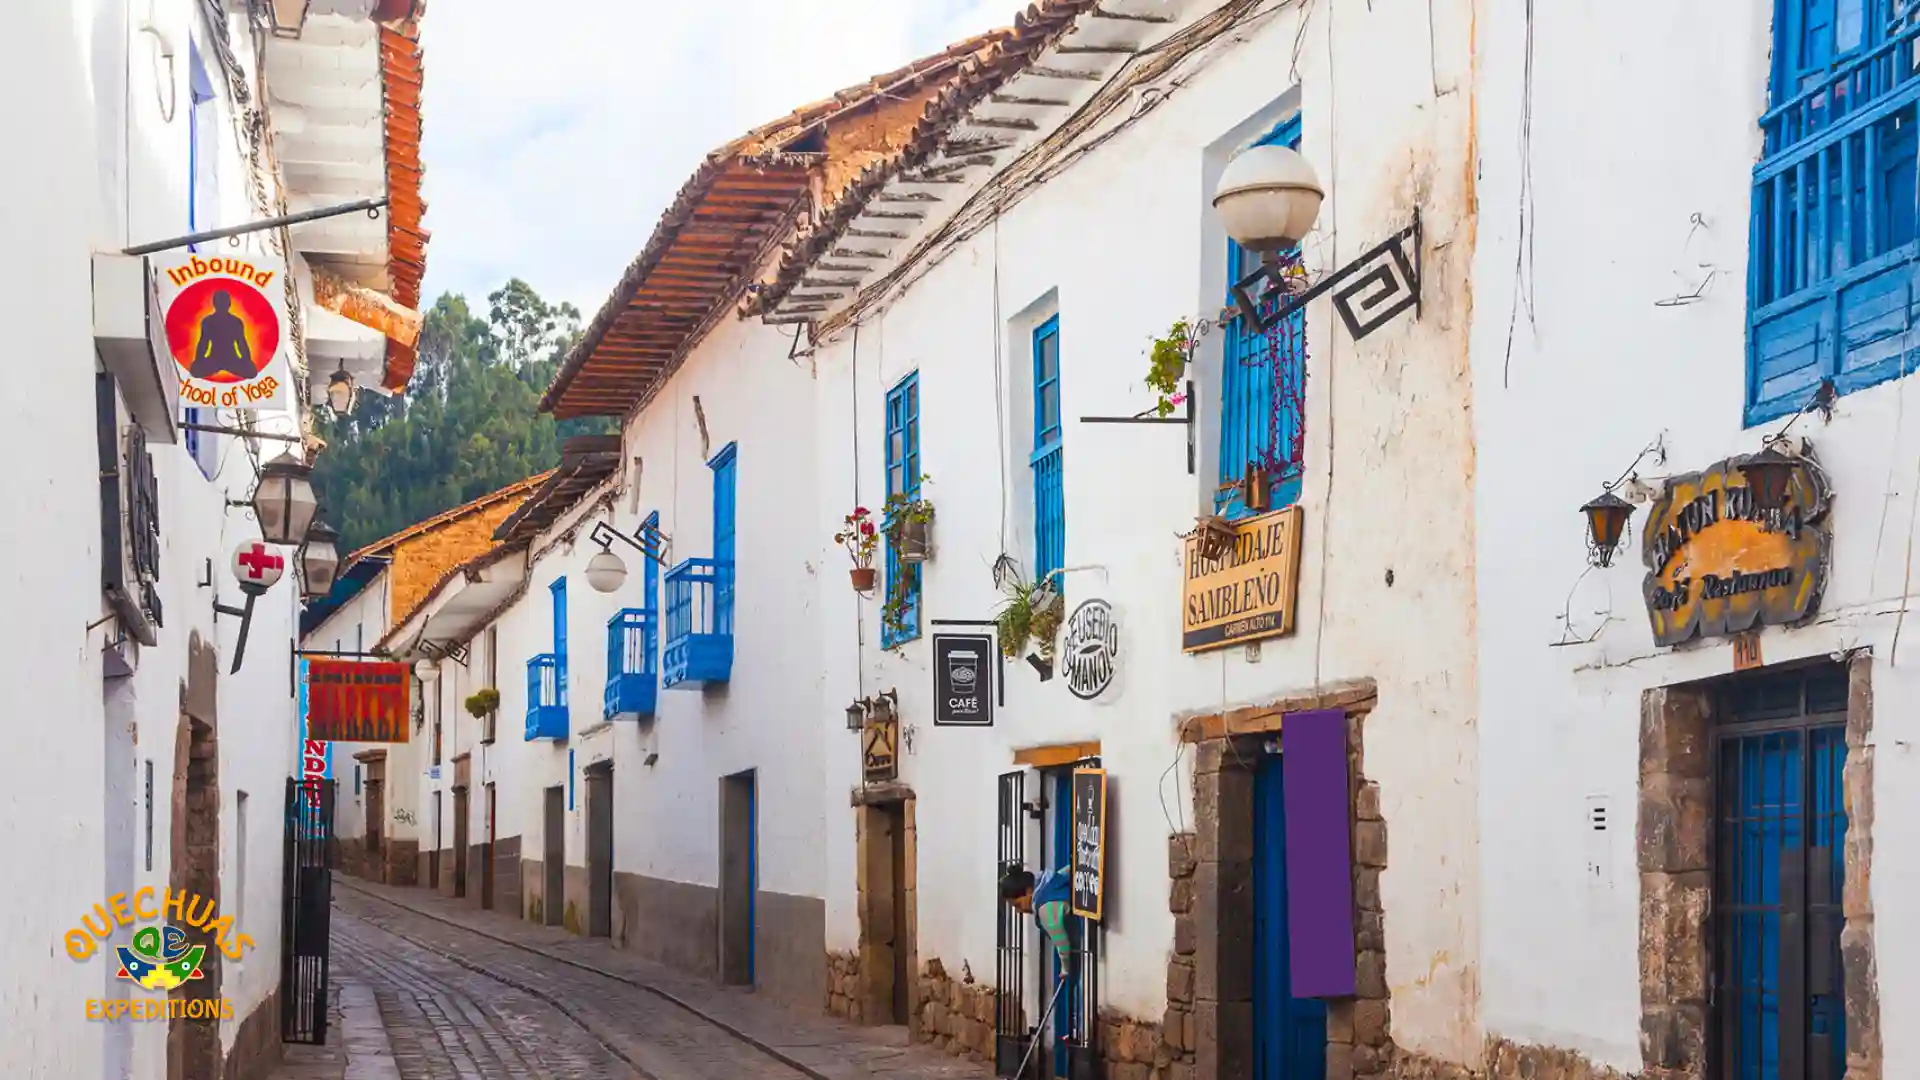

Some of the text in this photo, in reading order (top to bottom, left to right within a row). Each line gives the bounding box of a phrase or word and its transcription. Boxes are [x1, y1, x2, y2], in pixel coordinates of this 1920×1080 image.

[167, 255, 275, 288] Inbound
[179, 376, 280, 406] hool of Yoga
[1188, 568, 1280, 625] SAMBLEÑO
[949, 697, 977, 709] CAFÉ
